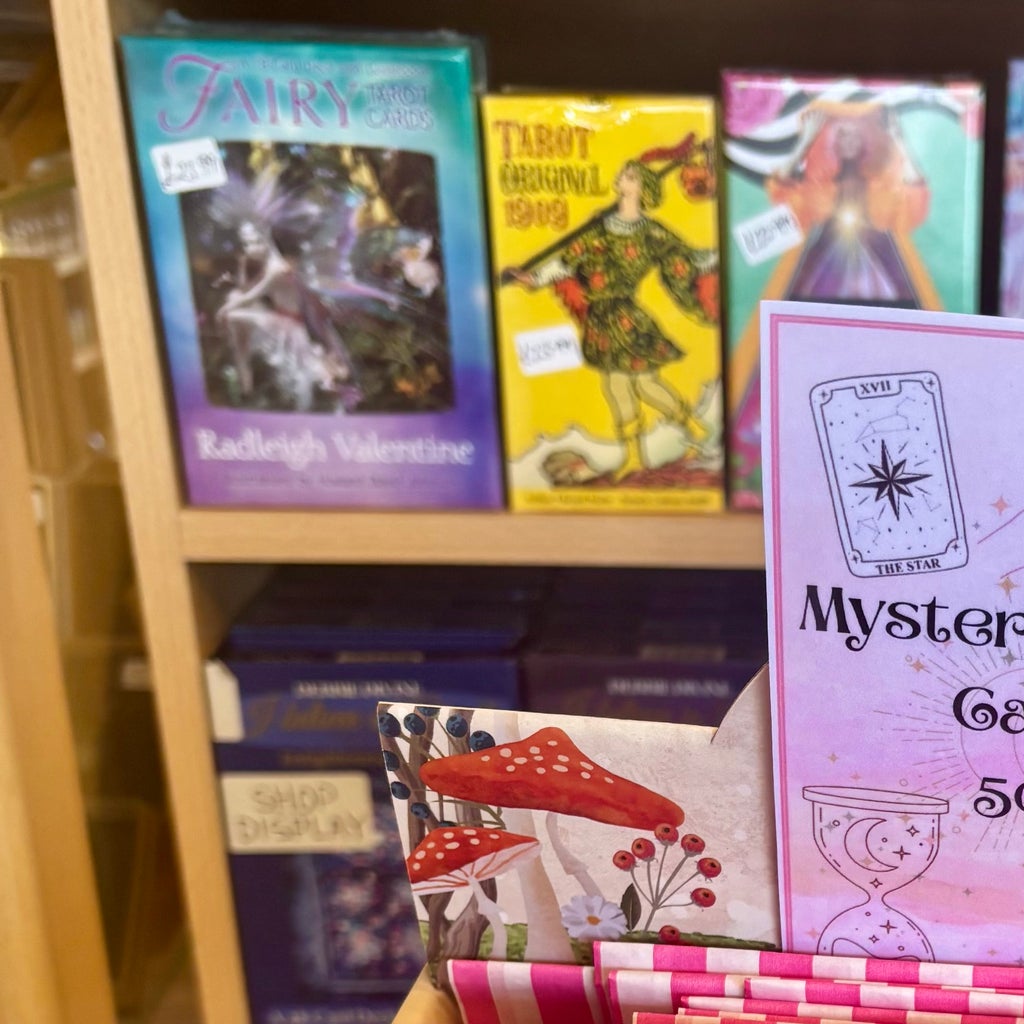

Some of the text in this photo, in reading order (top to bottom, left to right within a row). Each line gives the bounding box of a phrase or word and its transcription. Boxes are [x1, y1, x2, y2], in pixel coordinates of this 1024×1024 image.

[158, 54, 355, 133] FAIRY
[493, 120, 596, 160] TAROT
[503, 197, 569, 232] 1909
[859, 379, 892, 396] XVII
[196, 427, 475, 471] Radleigh Valentine
[875, 557, 941, 575] THE STAR
[250, 780, 340, 815] SHOP
[236, 812, 371, 845] DISPLAY
